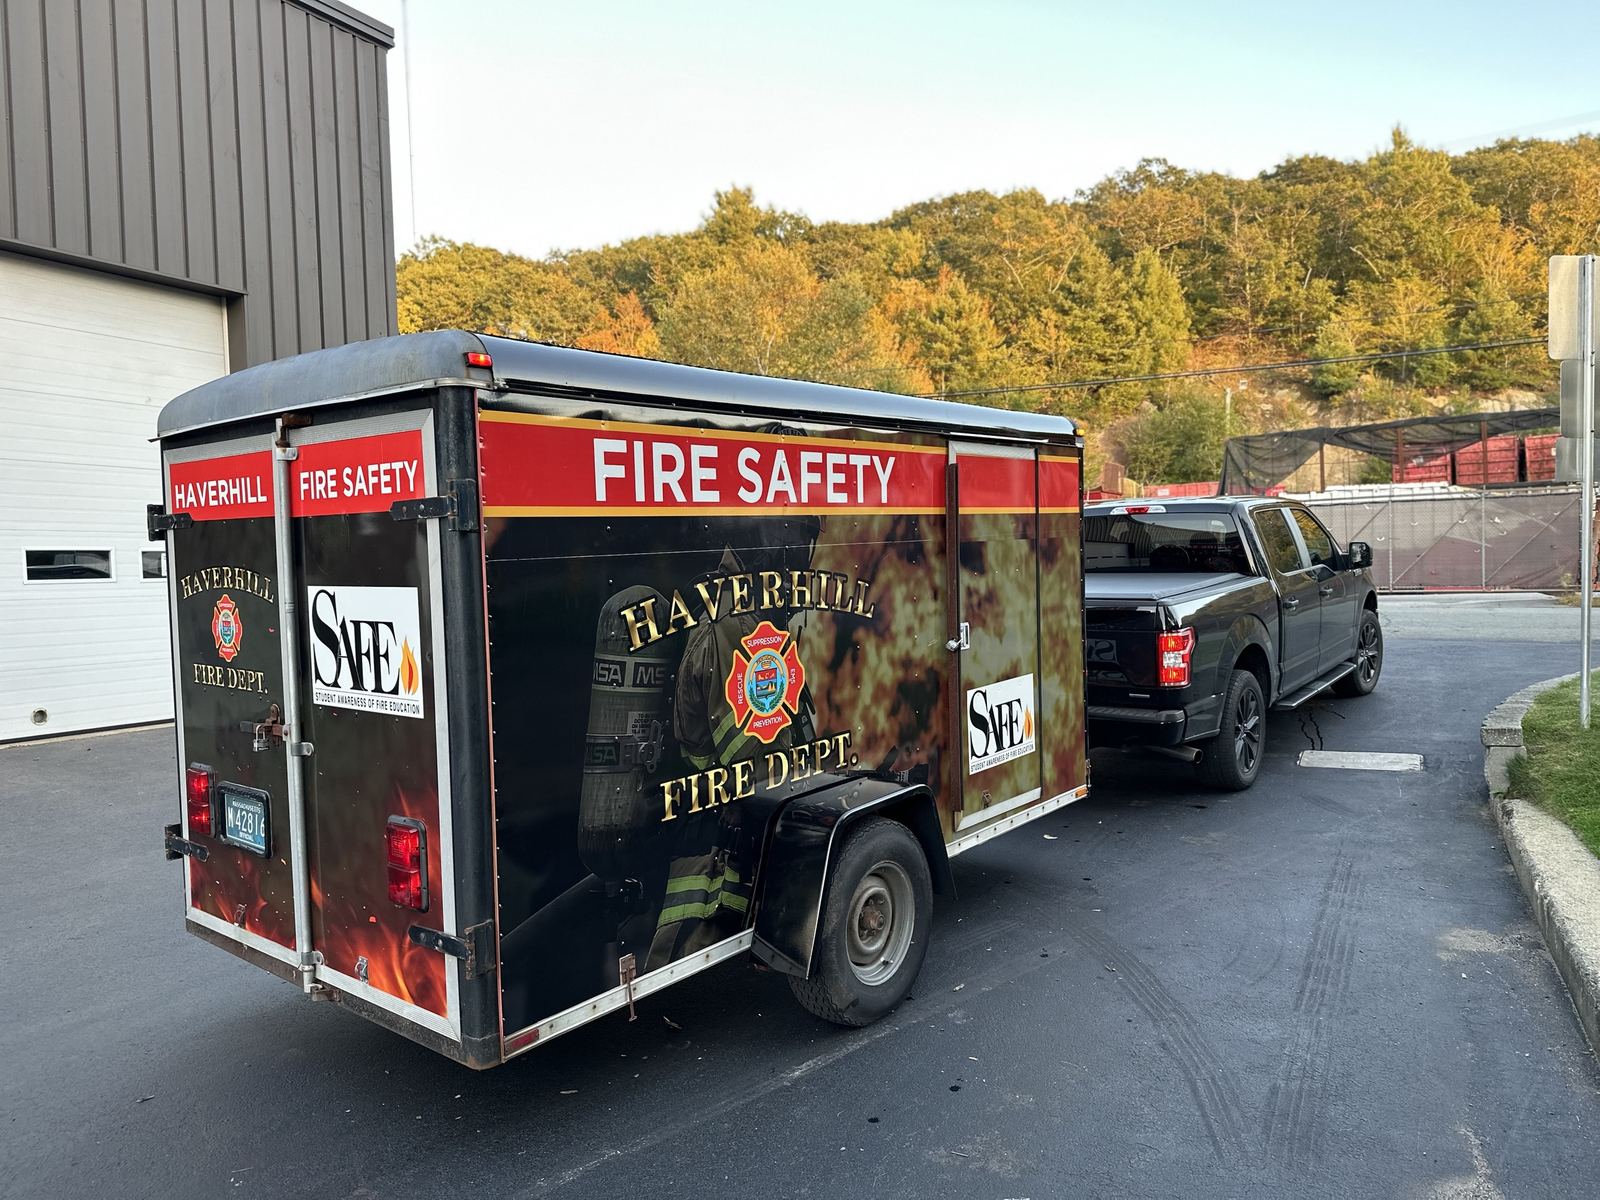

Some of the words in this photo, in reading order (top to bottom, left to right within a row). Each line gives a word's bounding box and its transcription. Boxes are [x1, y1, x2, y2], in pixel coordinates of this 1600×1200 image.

[300, 467, 338, 501] FIRE
[343, 460, 418, 498] SAFETY
[593, 438, 720, 502] FIRE
[737, 447, 896, 504] SAFETY
[175, 475, 267, 509] HAVERHILL
[180, 565, 275, 604] HAVERHILL
[620, 570, 877, 652] HAVERHILL
[312, 589, 400, 696] SAFE
[747, 636, 782, 648] SUPPRESSION
[193, 663, 225, 687] FIRE
[227, 668, 269, 695] DEPT.
[315, 692, 336, 703] STUDENT
[337, 694, 367, 708] AWARENESS
[367, 698, 375, 709] OF
[376, 700, 388, 711] FIRE
[390, 701, 420, 715] EDUCATION
[752, 716, 783, 729] PREVENTION
[969, 689, 1023, 760] SAFE
[660, 759, 756, 823] FIRE
[764, 732, 859, 791] DEPT.
